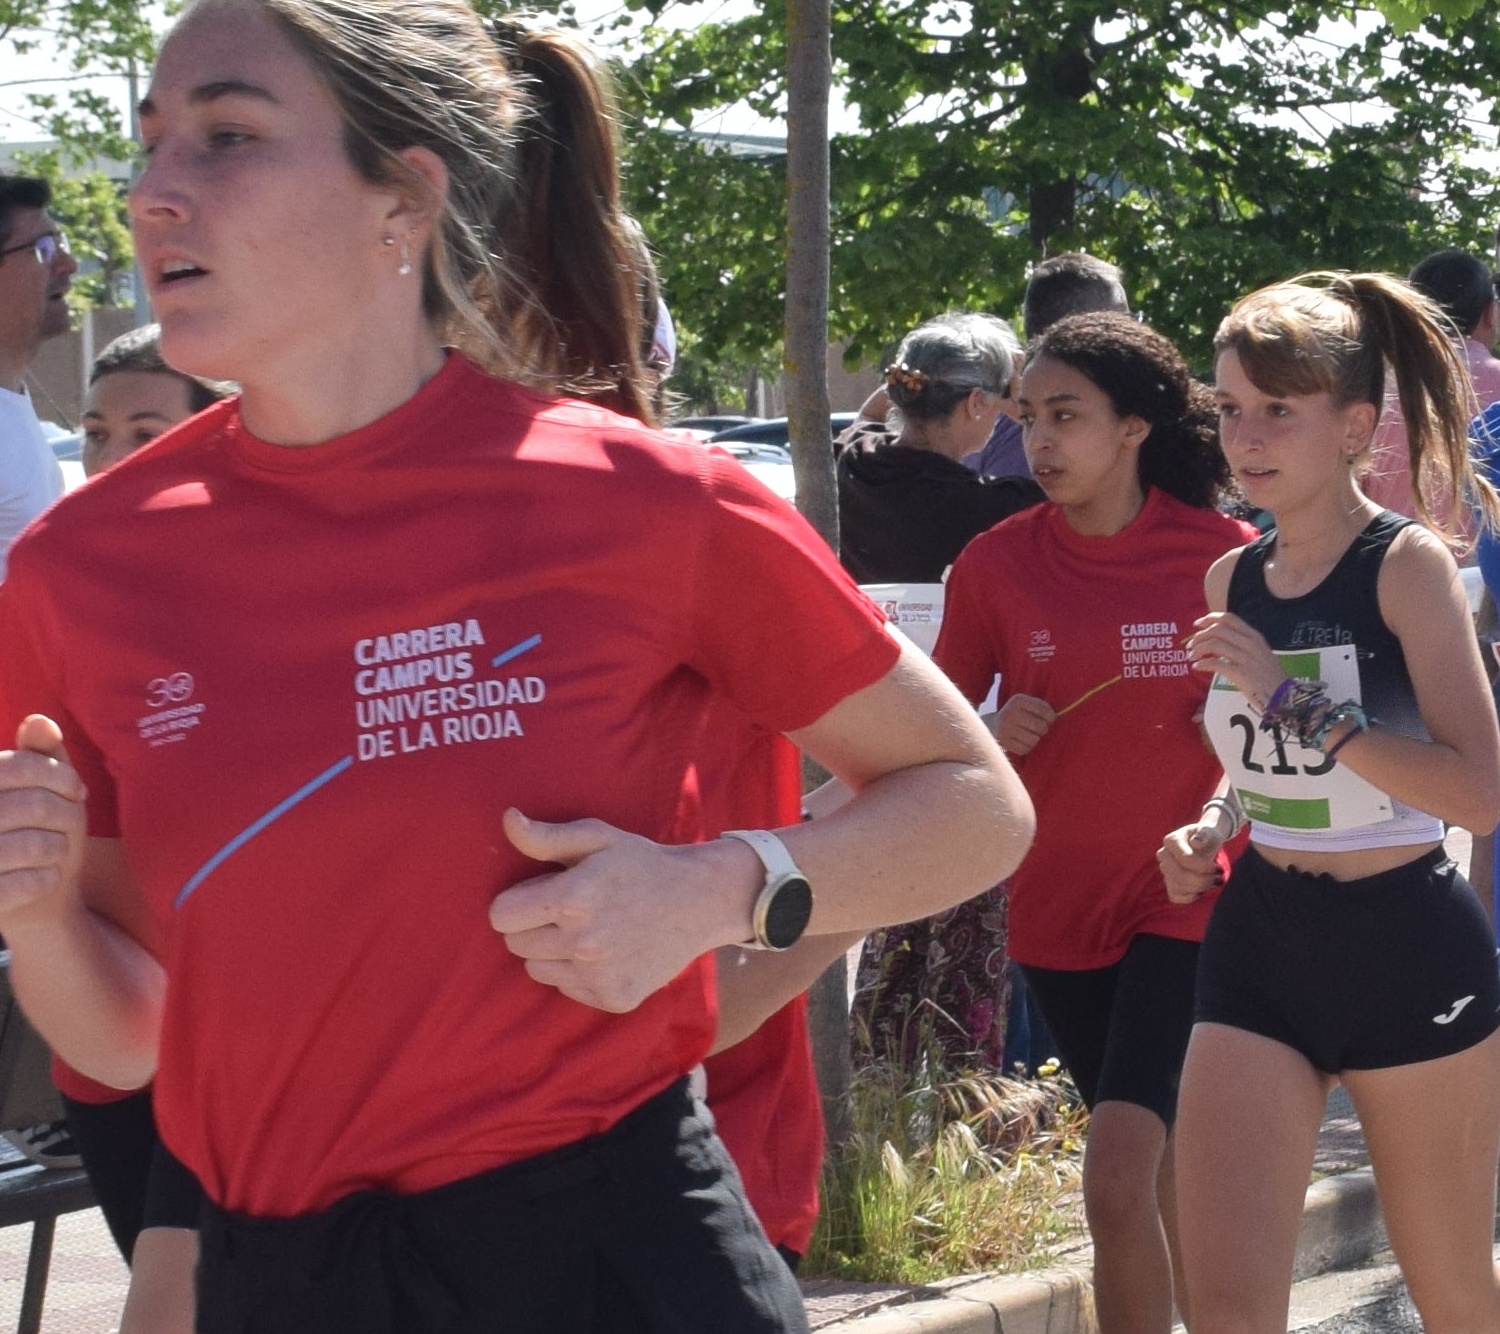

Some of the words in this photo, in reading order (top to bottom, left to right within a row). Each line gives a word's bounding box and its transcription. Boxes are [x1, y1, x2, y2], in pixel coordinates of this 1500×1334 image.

[354, 619, 485, 666] CARRERA
[1121, 622, 1178, 637] CARRERA
[1122, 637, 1173, 651] CAMPUS
[1122, 650, 1191, 665] UNIVERSIDA
[1123, 666, 1140, 678] DE
[1141, 666, 1157, 678] LA
[1159, 664, 1190, 677] RIOJA
[355, 652, 474, 696] CAMPUS
[356, 676, 547, 728] UNIVERSIDAD
[357, 729, 396, 761] DE
[400, 721, 439, 753] LA
[442, 709, 525, 746] RIOJA
